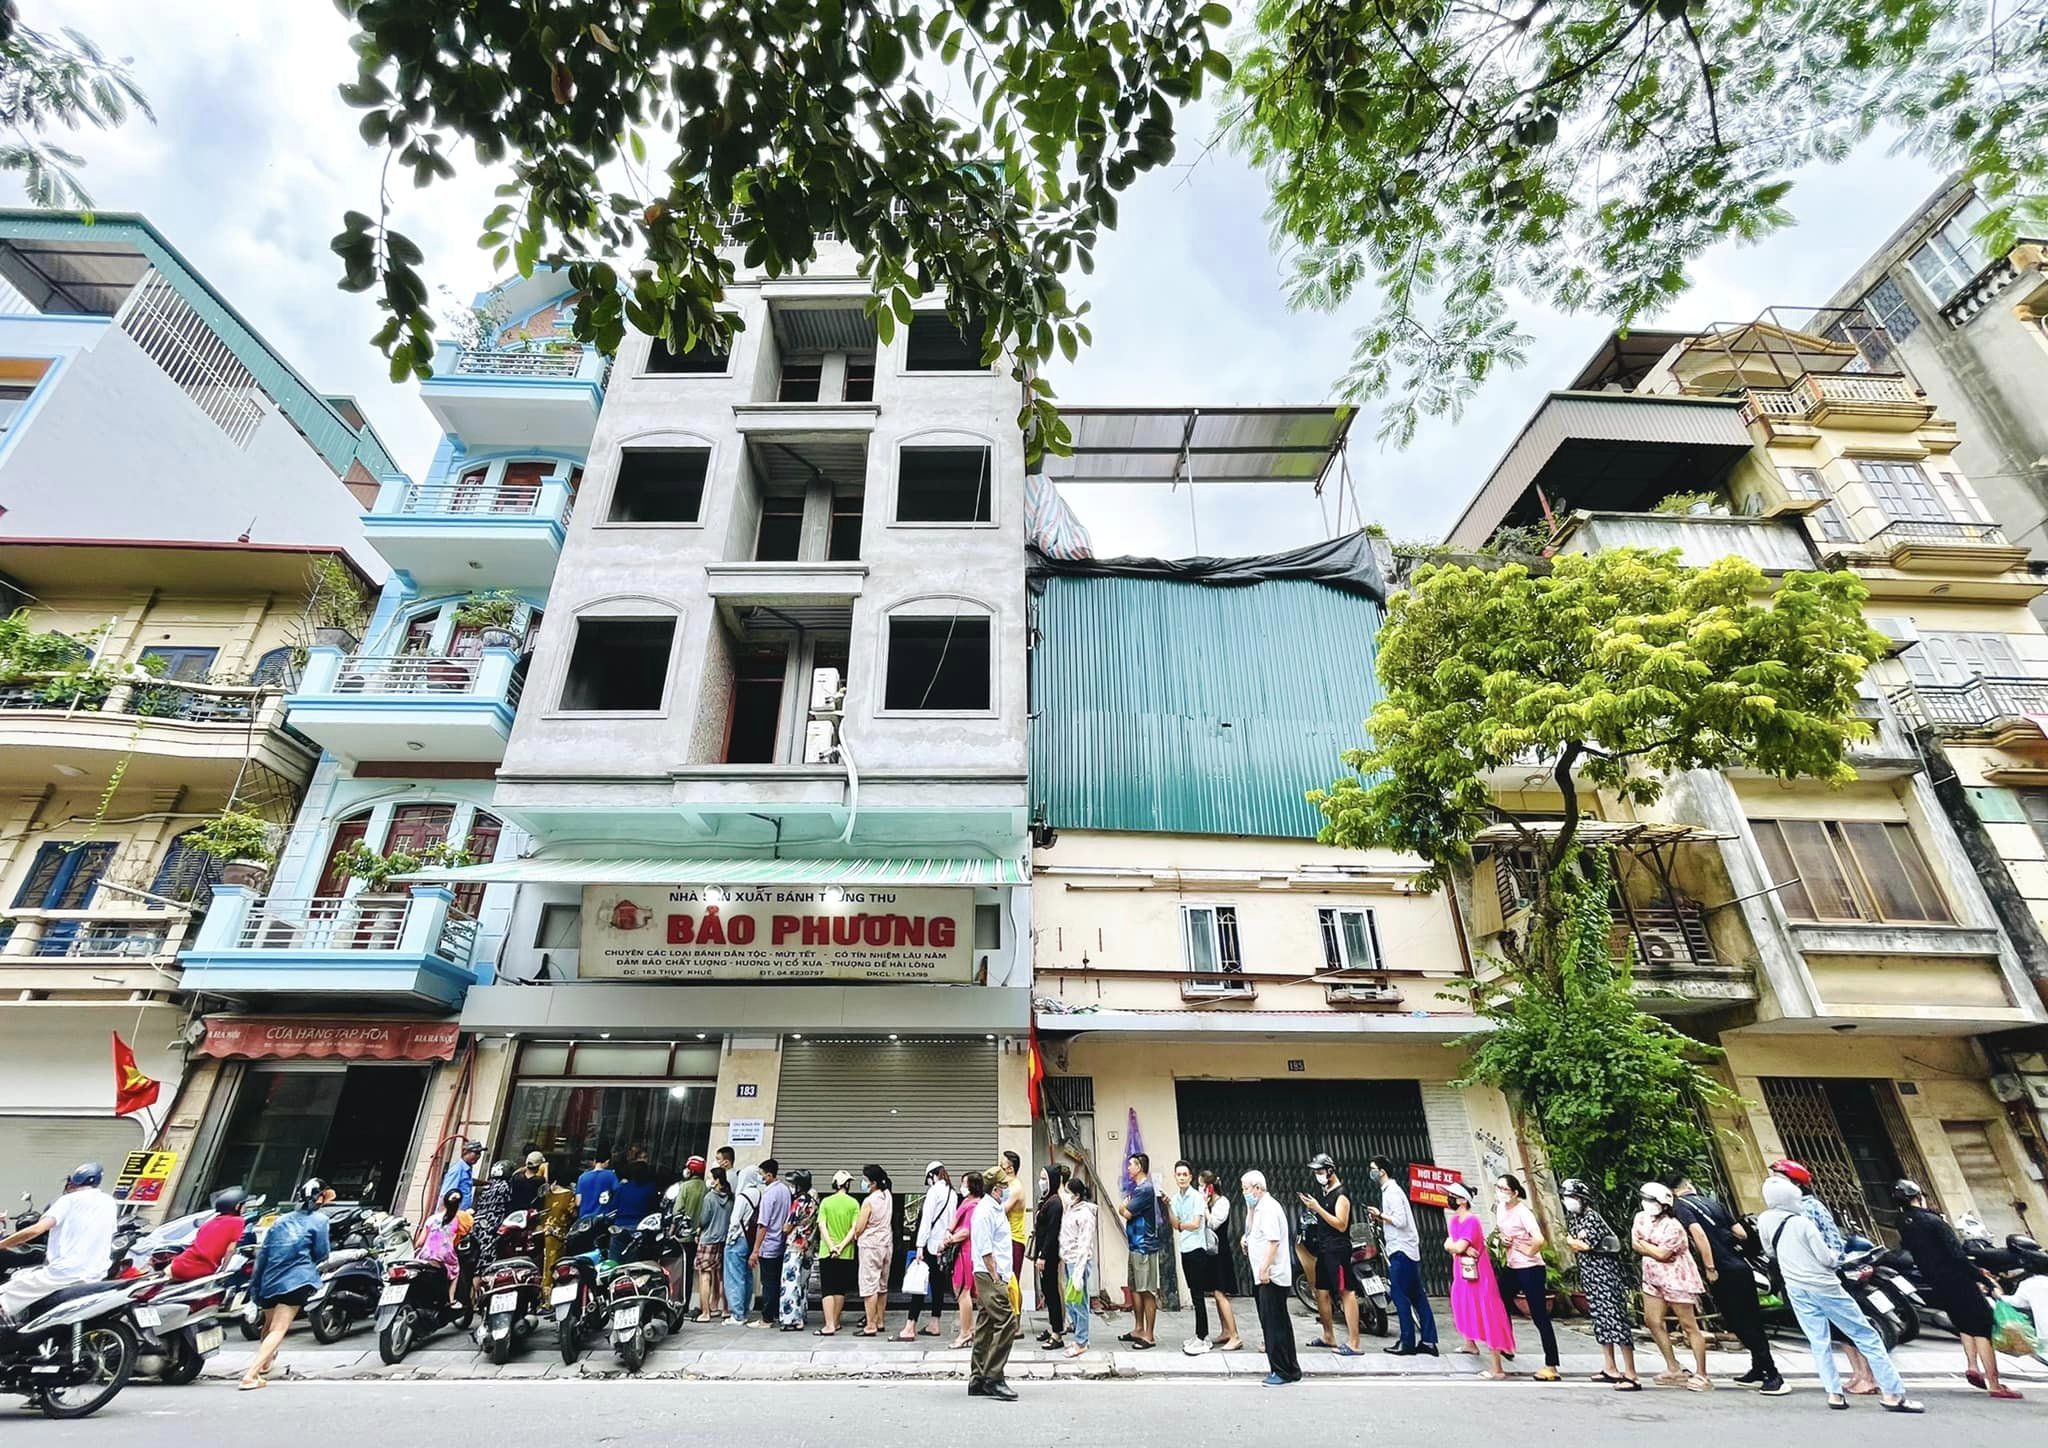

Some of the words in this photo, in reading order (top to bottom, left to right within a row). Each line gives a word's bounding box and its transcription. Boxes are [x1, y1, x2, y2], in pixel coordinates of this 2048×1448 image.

[669, 890, 698, 901] NHÀ
[735, 888, 773, 902] XUẤT
[776, 890, 814, 902] BÁNH
[818, 892, 865, 902] TNG
[869, 893, 896, 903] THU
[667, 905, 755, 945] BẢO
[772, 913, 956, 947] PHƯƠNG
[646, 949, 667, 957] CÁC
[747, 950, 767, 958] TỘC
[740, 1086, 755, 1096] 183
[1443, 1172, 1454, 1183] XE
